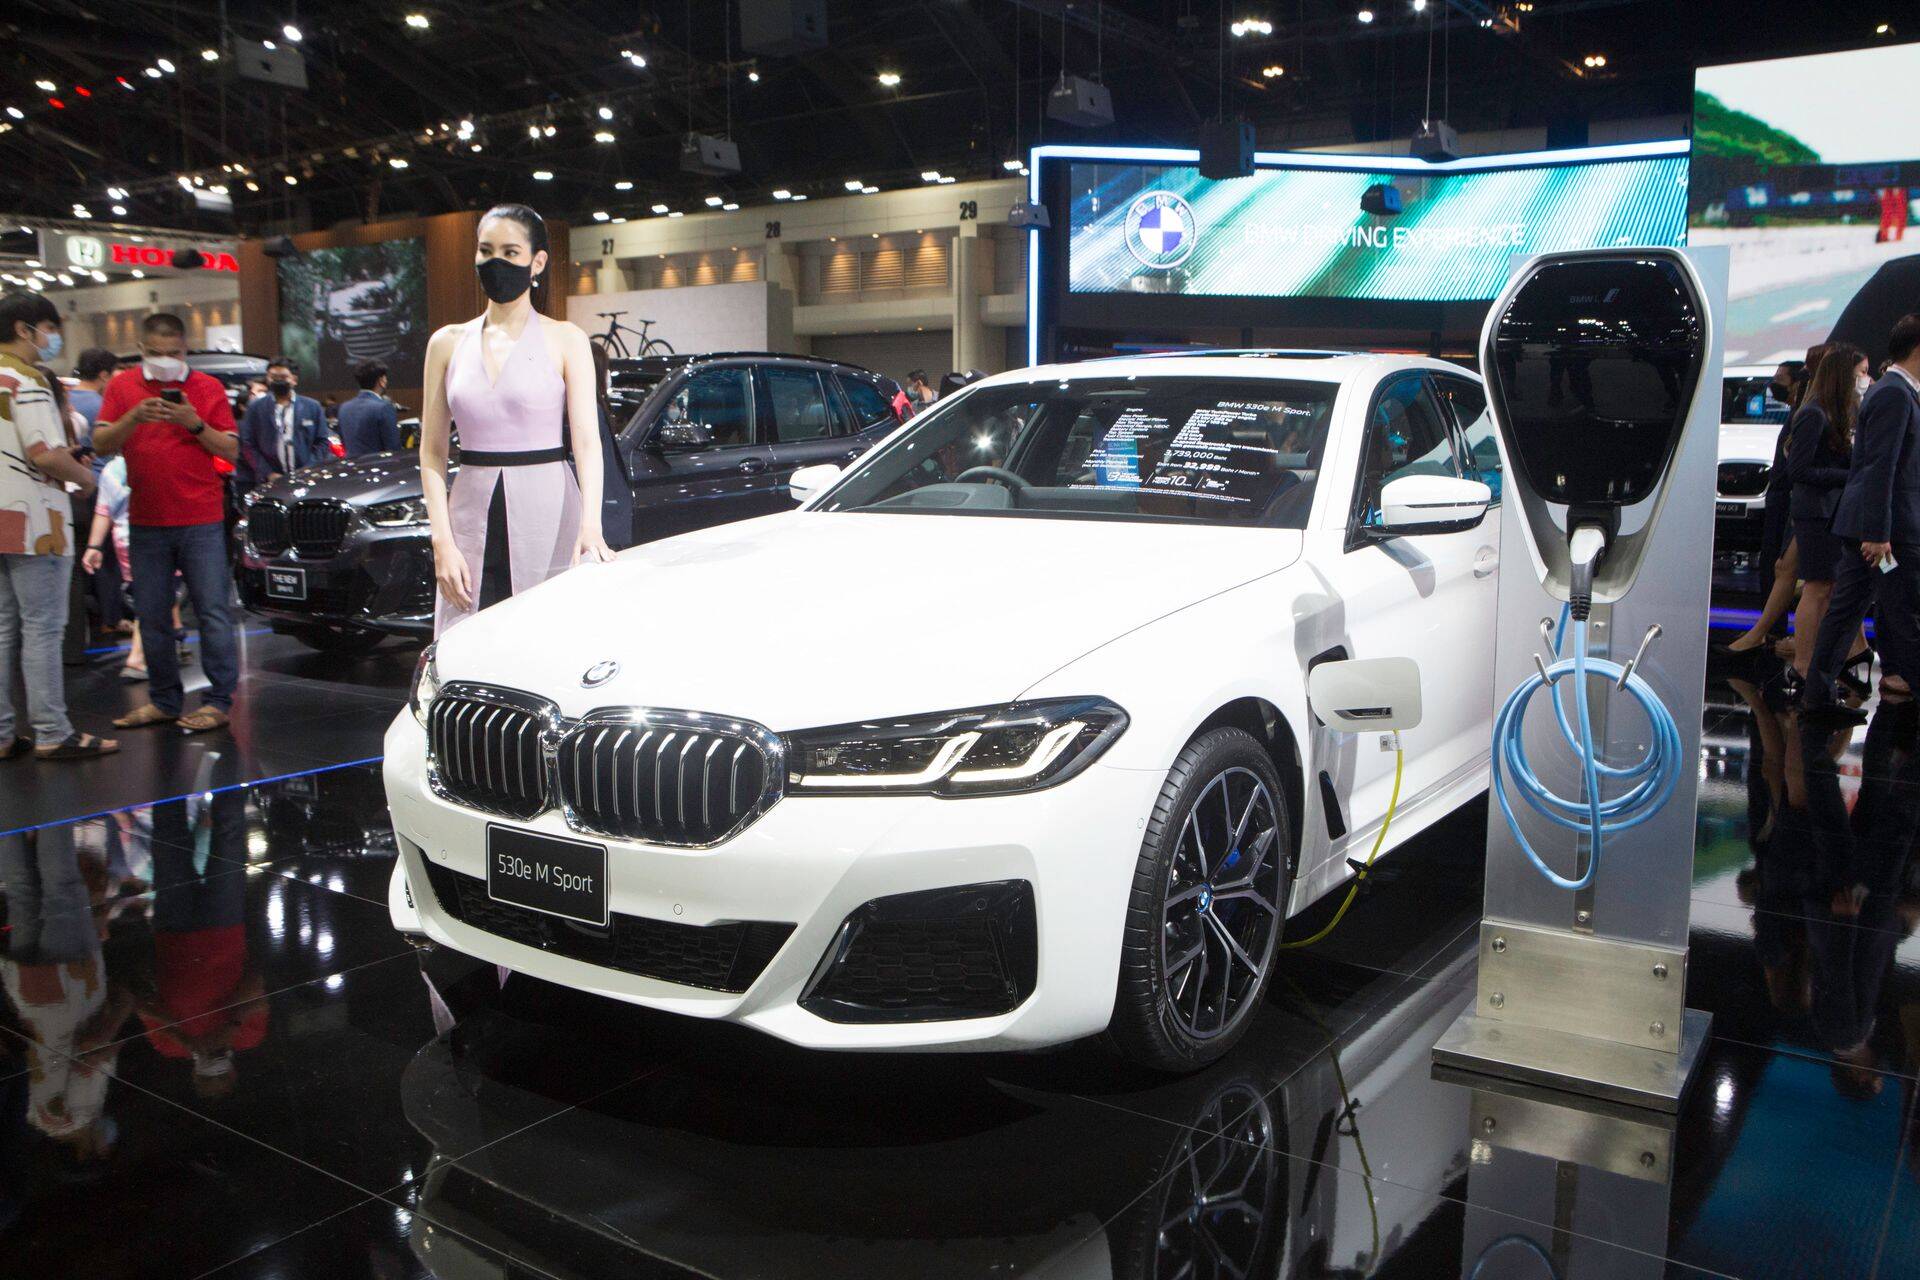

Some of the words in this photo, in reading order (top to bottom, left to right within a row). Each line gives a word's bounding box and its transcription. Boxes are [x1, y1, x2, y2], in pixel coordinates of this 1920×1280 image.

[960, 200, 977, 219] 29
[766, 221, 781, 238] 28
[1393, 224, 1527, 250] EXPERIENCE
[602, 238, 614, 255] 27
[1217, 401, 1244, 409] BMW
[1163, 449, 1214, 460] 3,739,000
[498, 853, 532, 880] 530e
[535, 862, 549, 883] M
[553, 866, 593, 894] Sport
